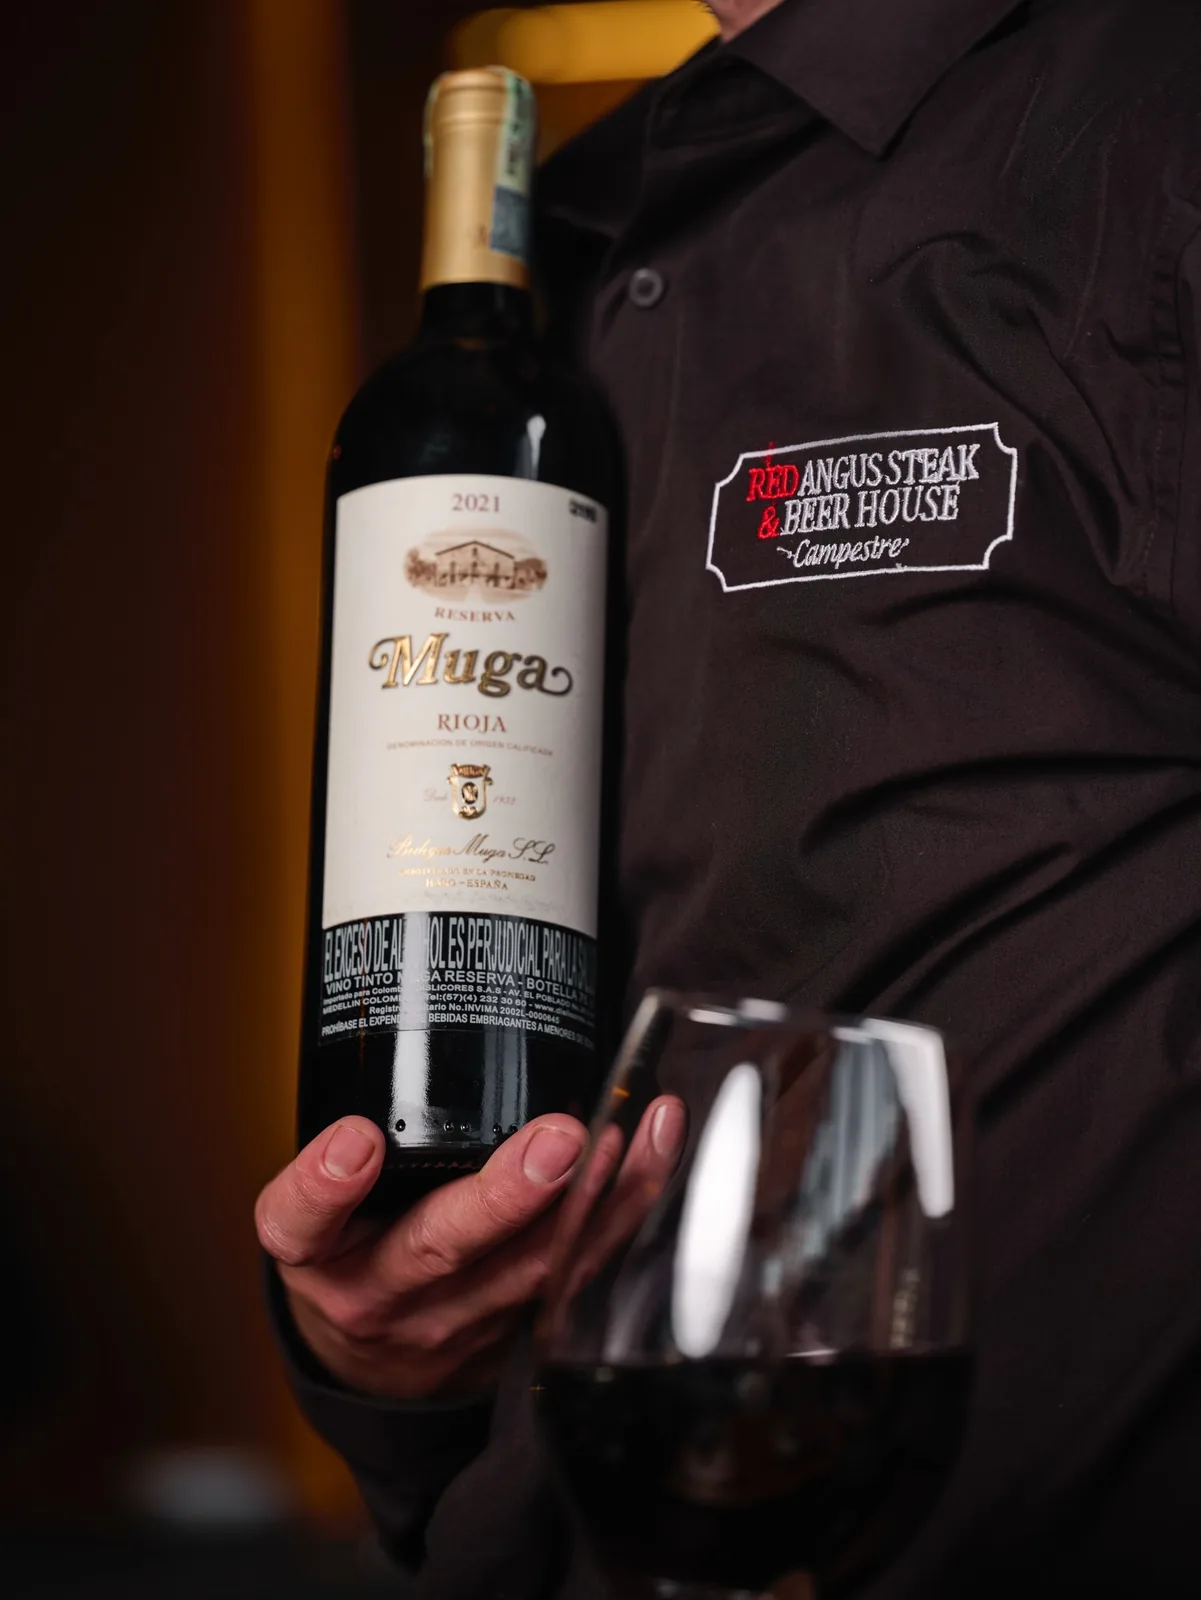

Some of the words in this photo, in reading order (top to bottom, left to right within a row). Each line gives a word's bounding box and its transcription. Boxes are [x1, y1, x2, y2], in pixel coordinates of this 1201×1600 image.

[746, 463, 799, 501] RED
[797, 453, 884, 497] ANGUS
[885, 443, 980, 485] STEAK
[451, 493, 502, 514] 2021
[757, 505, 780, 539] &
[780, 495, 851, 536] BEER
[855, 485, 960, 528] HOUSE
[789, 535, 910, 569] Campestre
[434, 606, 516, 623] RESERVA
[368, 632, 574, 698] Muga
[437, 713, 507, 734] RIOJA
[456, 739, 468, 748] DE
[470, 739, 505, 750] ORIGEN
[506, 742, 554, 757] CALIFICADA
[453, 832, 507, 864] Muga
[462, 867, 474, 876] EN
[477, 868, 488, 876] LA
[490, 868, 536, 882] PROPIEDAD
[467, 878, 509, 890] ESPAÑA
[323, 930, 333, 983] EL
[334, 921, 373, 980] EXCESO
[373, 919, 390, 972] DE
[389, 916, 446, 971] ALHOL
[448, 916, 465, 970] ES
[466, 917, 541, 977] PERJUDICIAL
[542, 927, 567, 984] PARA
[325, 978, 352, 995] VINO
[354, 972, 394, 988] TINTO
[444, 970, 515, 987] RESERVA
[526, 977, 578, 1002] BOTELLA
[322, 999, 361, 1015] MEDELLIN
[479, 995, 498, 1004] 232
[500, 996, 513, 1005] 30
[323, 992, 353, 1006] Importado
[353, 989, 371, 999] para
[523, 990, 534, 999] EL
[358, 1017, 368, 1028] EL
[428, 1012, 468, 1023] BEBIDAS
[469, 1013, 537, 1031] EMBRIAGANTES
[537, 1022, 544, 1033] A
